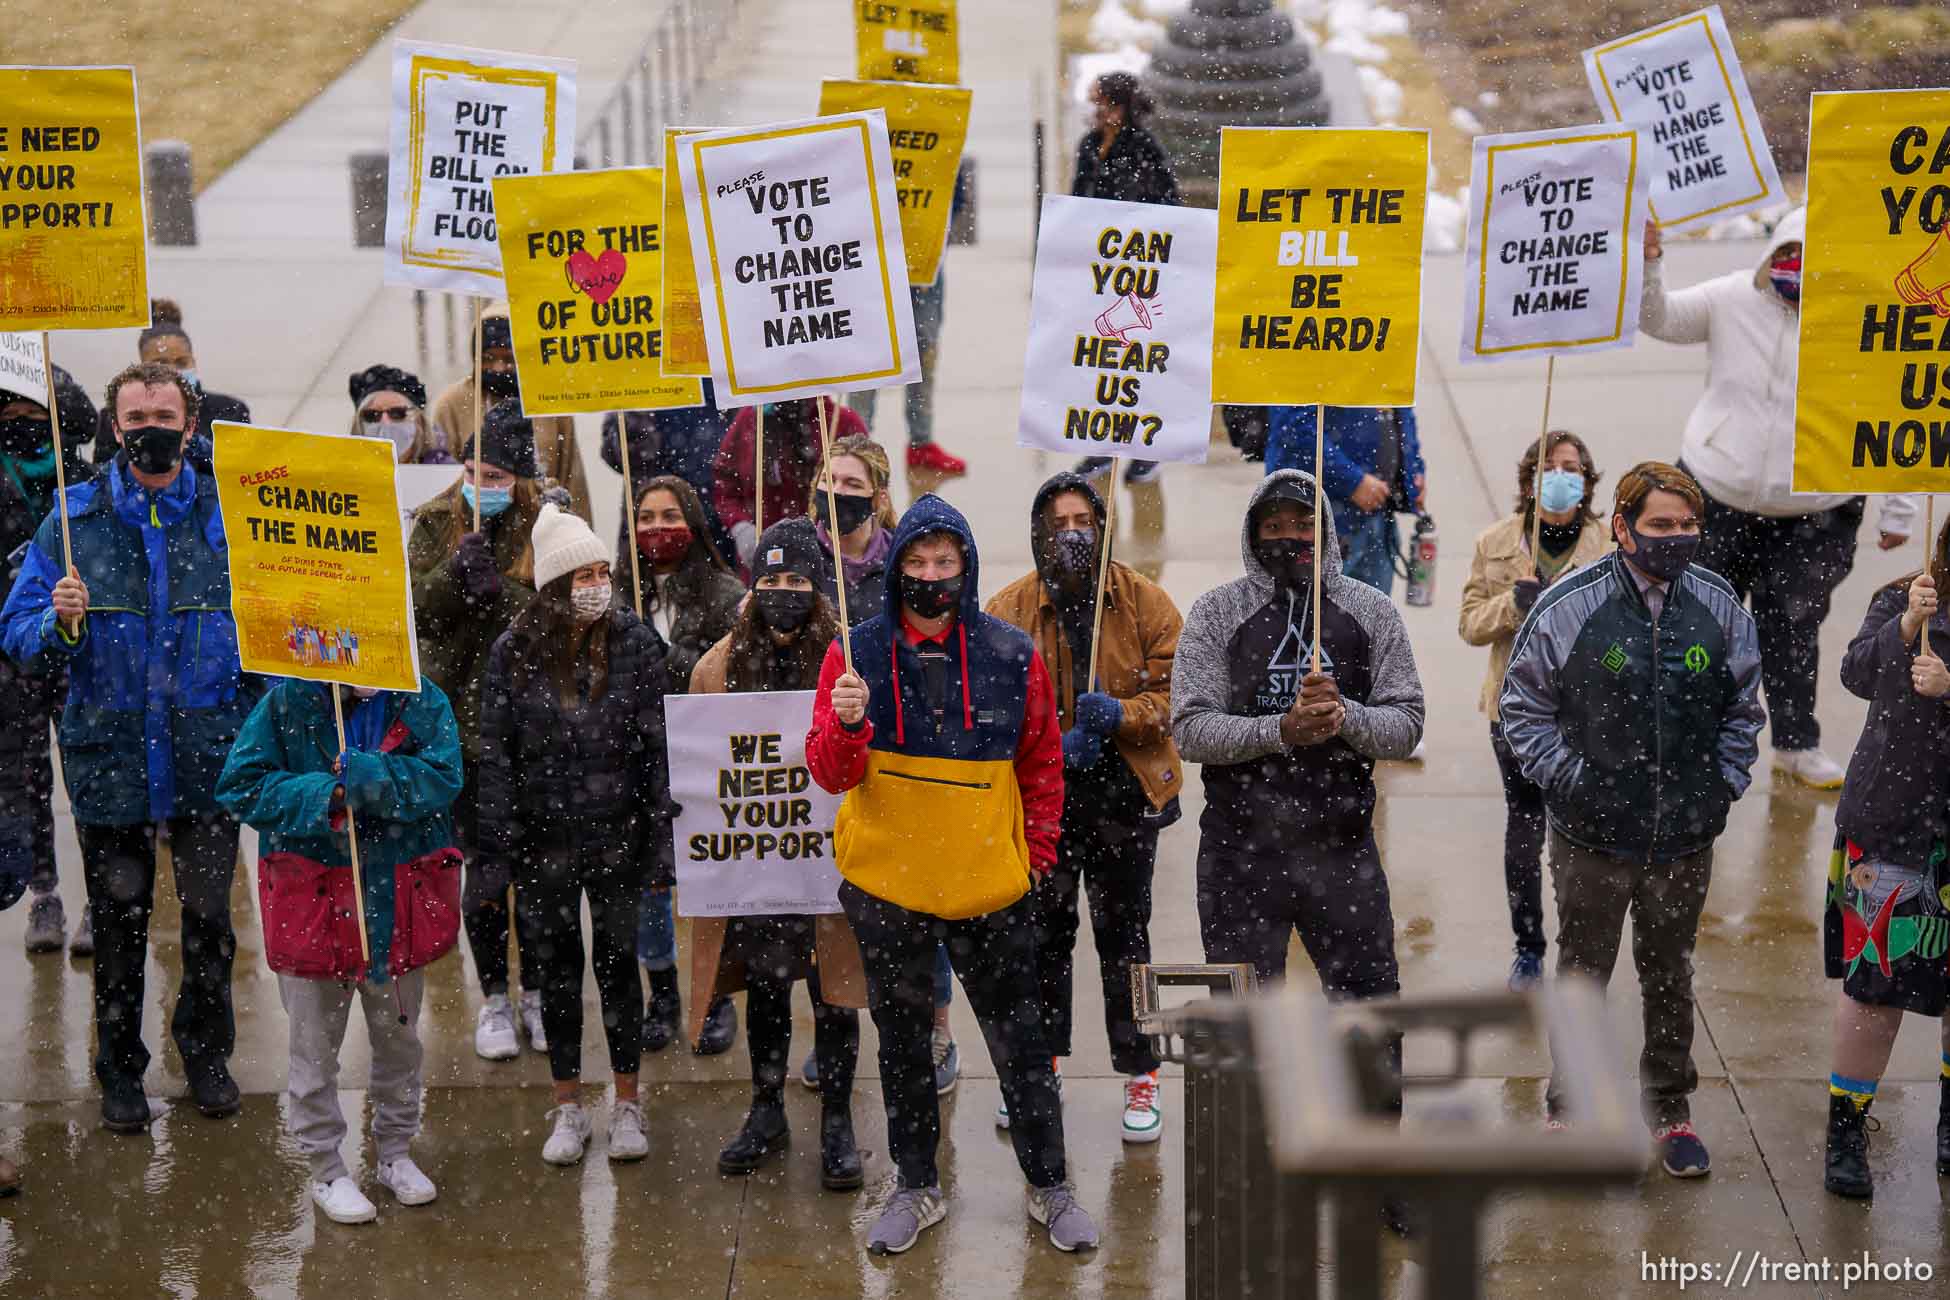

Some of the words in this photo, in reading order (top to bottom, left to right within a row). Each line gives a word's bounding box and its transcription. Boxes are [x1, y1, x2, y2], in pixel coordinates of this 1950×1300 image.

[1636, 60, 1694, 95] VOTE
[456, 101, 508, 128] PUT
[1657, 89, 1687, 115] TO
[22, 126, 100, 152] NEED
[1652, 102, 1725, 144] HANGE
[454, 129, 506, 157] THE
[1667, 133, 1711, 164] THE
[1889, 126, 1950, 176] CA
[430, 156, 484, 183] BILL
[717, 170, 765, 198] PLEASE
[1667, 155, 1727, 192] NAME
[745, 177, 831, 214] VOTE
[1236, 188, 1311, 223] LET
[1326, 188, 1405, 224] THE
[1523, 176, 1594, 207] VOTE
[2, 202, 113, 229] PPORT!
[1540, 207, 1574, 233] TO
[1880, 184, 1950, 235] YO
[434, 214, 497, 242] FLOO
[528, 229, 585, 259] FOR
[597, 224, 660, 253] THE
[772, 213, 813, 244] TO
[1097, 226, 1173, 264] CAN
[734, 240, 863, 284] CHANGE
[1277, 230, 1359, 266] BILL
[1500, 230, 1609, 264] CHANGE
[1089, 261, 1160, 299] YOU
[1290, 273, 1343, 309] BE
[1527, 261, 1580, 288] THE
[771, 278, 835, 312] THE
[1512, 287, 1590, 317] NAME
[538, 300, 577, 331] OF
[591, 295, 654, 327] OUR
[763, 309, 853, 348] NAME
[1859, 304, 1950, 353] HE
[540, 329, 662, 366] FUTURE
[1239, 314, 1392, 352] HEARD!
[1072, 333, 1170, 374] HEAR
[1095, 372, 1141, 408] US
[1064, 405, 1164, 446] NOW?
[239, 465, 289, 487] PLEASE
[257, 484, 360, 517] CHANGE
[246, 517, 296, 545] THE
[305, 524, 378, 554] NAME
[258, 561, 276, 572] OUR
[278, 564, 306, 576] FUTURE
[729, 733, 782, 764] WE
[717, 766, 810, 799] NEED
[719, 798, 812, 829] YOUR
